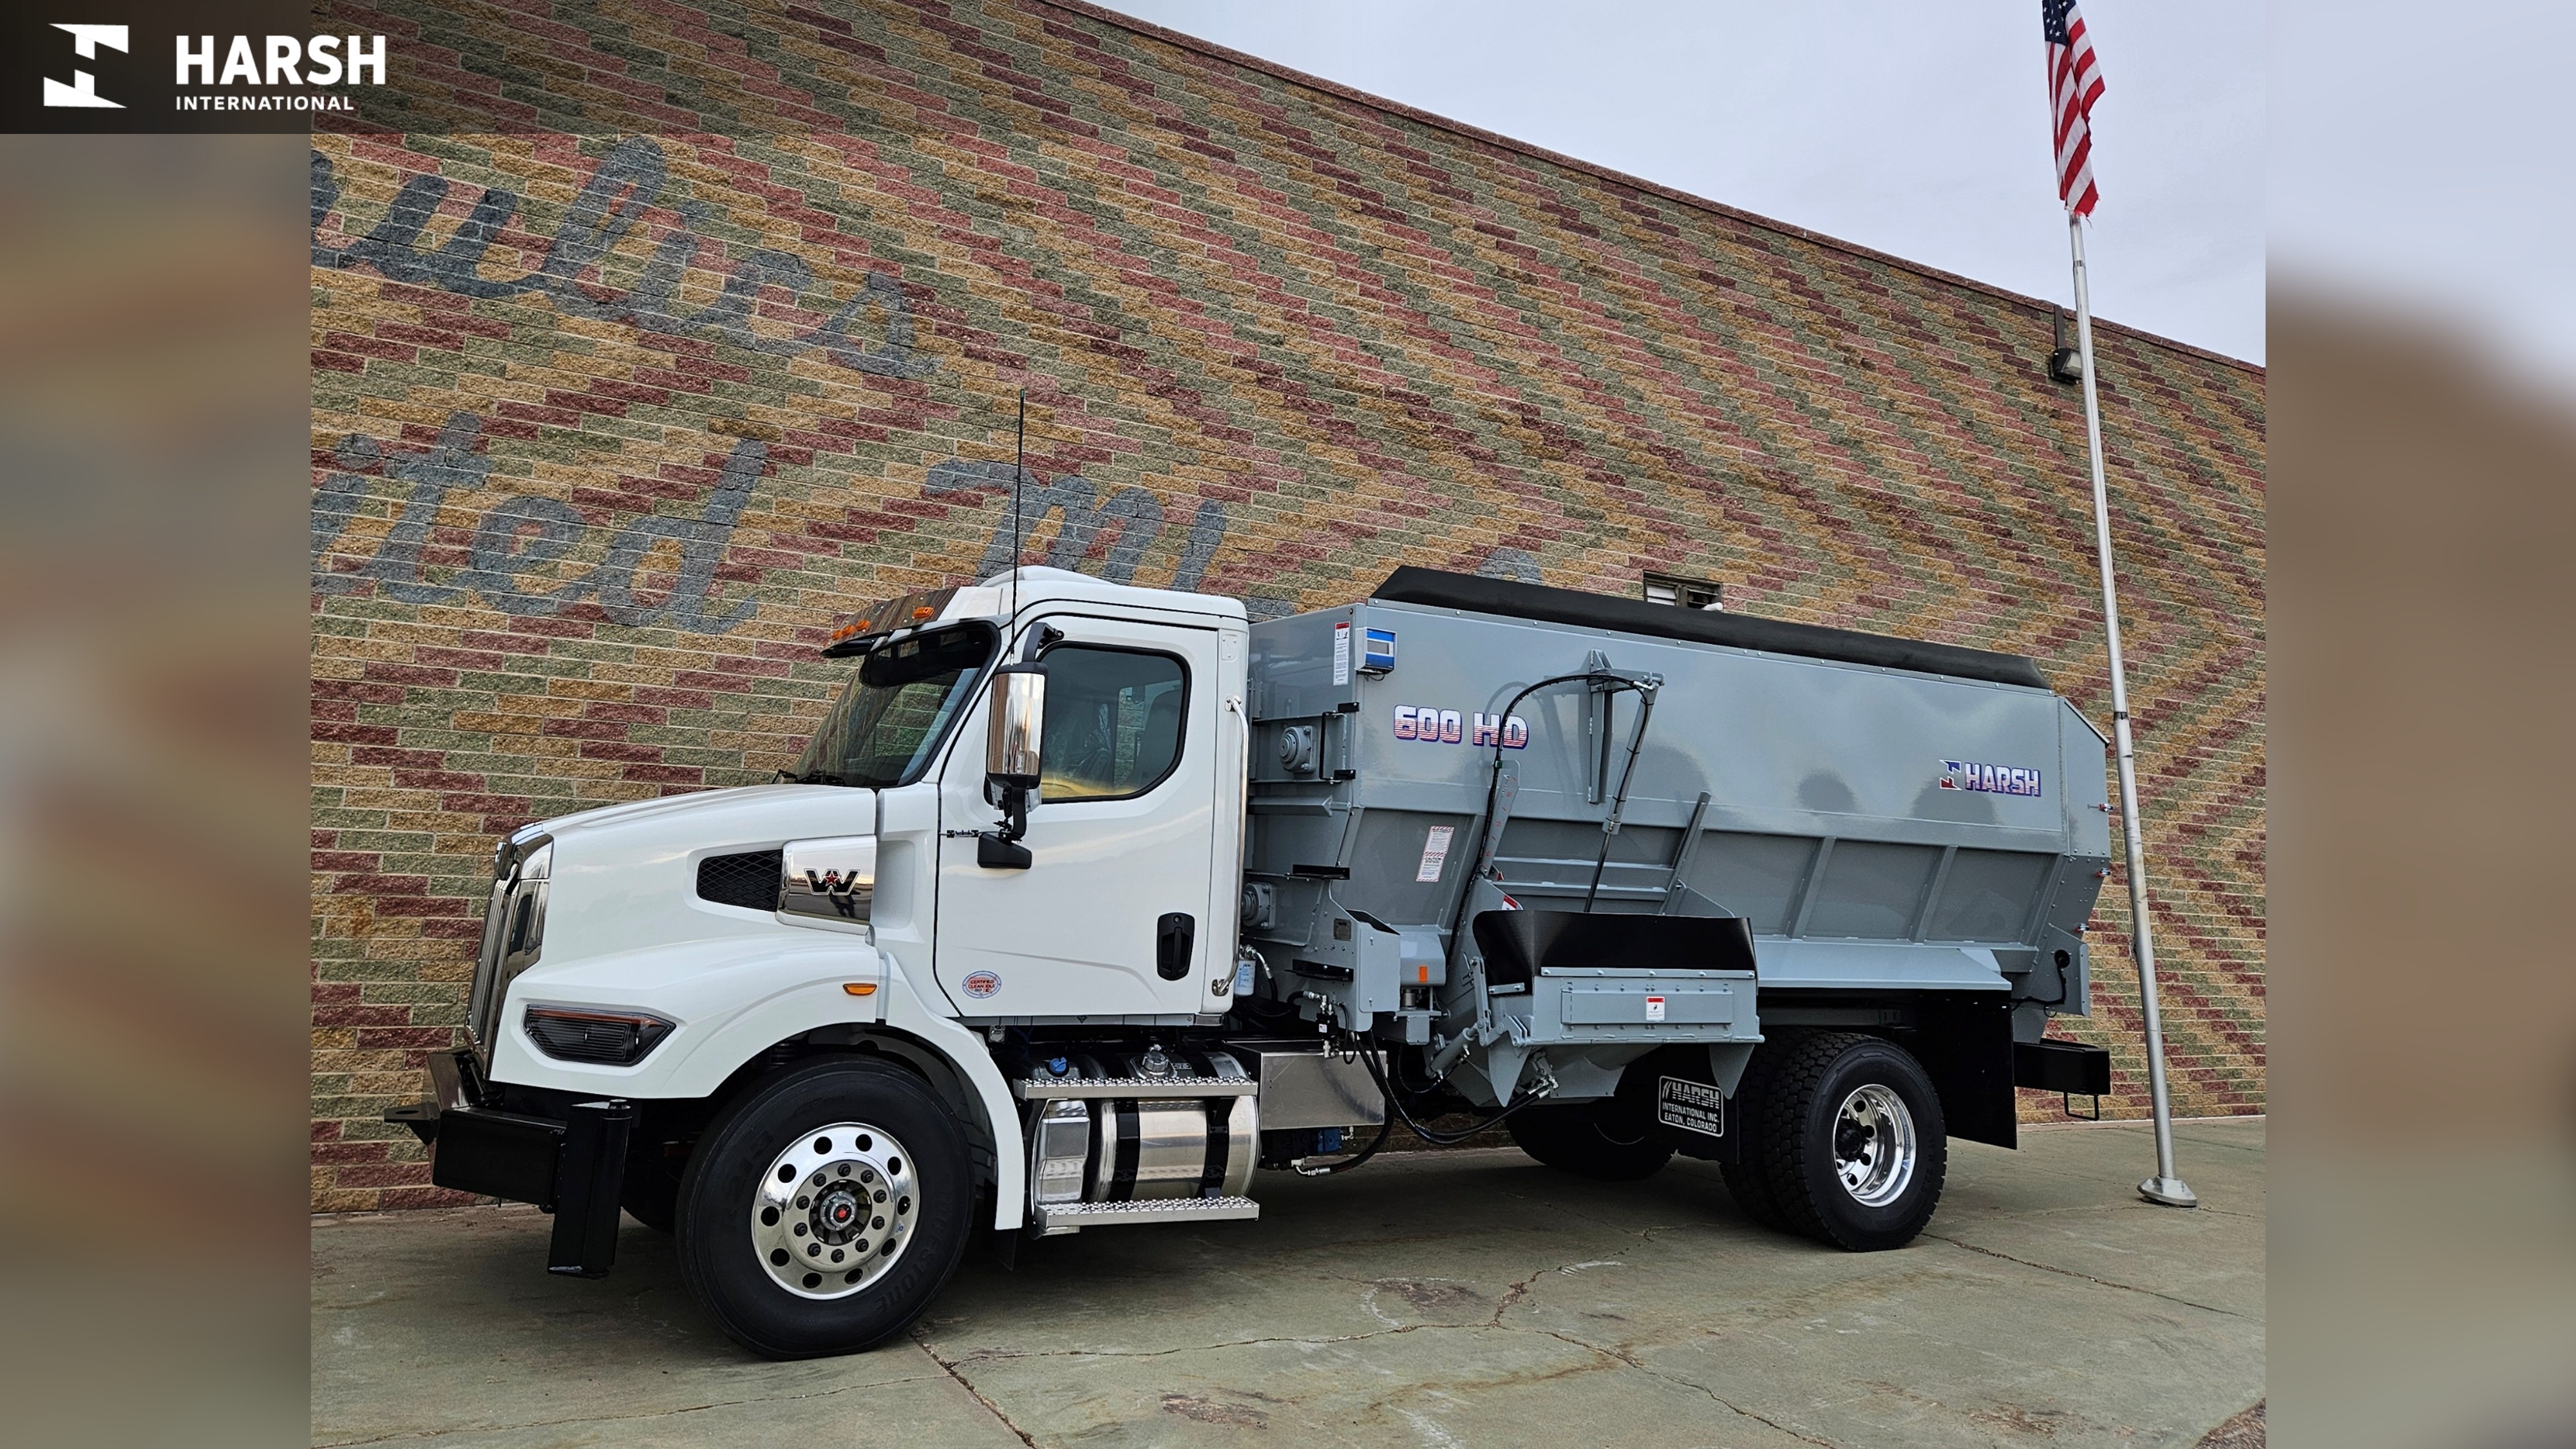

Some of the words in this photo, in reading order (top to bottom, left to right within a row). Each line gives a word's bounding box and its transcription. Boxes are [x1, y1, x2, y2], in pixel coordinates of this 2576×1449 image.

[1394, 705, 1462, 744] 600
[1473, 712, 1529, 750] HD
[1965, 762, 2041, 797] HARSH
[1672, 1082, 1719, 1109] HARSH
[1662, 1101, 1706, 1120] INTERNATIONAL
[1707, 1112, 1719, 1123] INC.
[1664, 1112, 1685, 1126] EATON,
[1687, 1117, 1717, 1133] COLORADO
